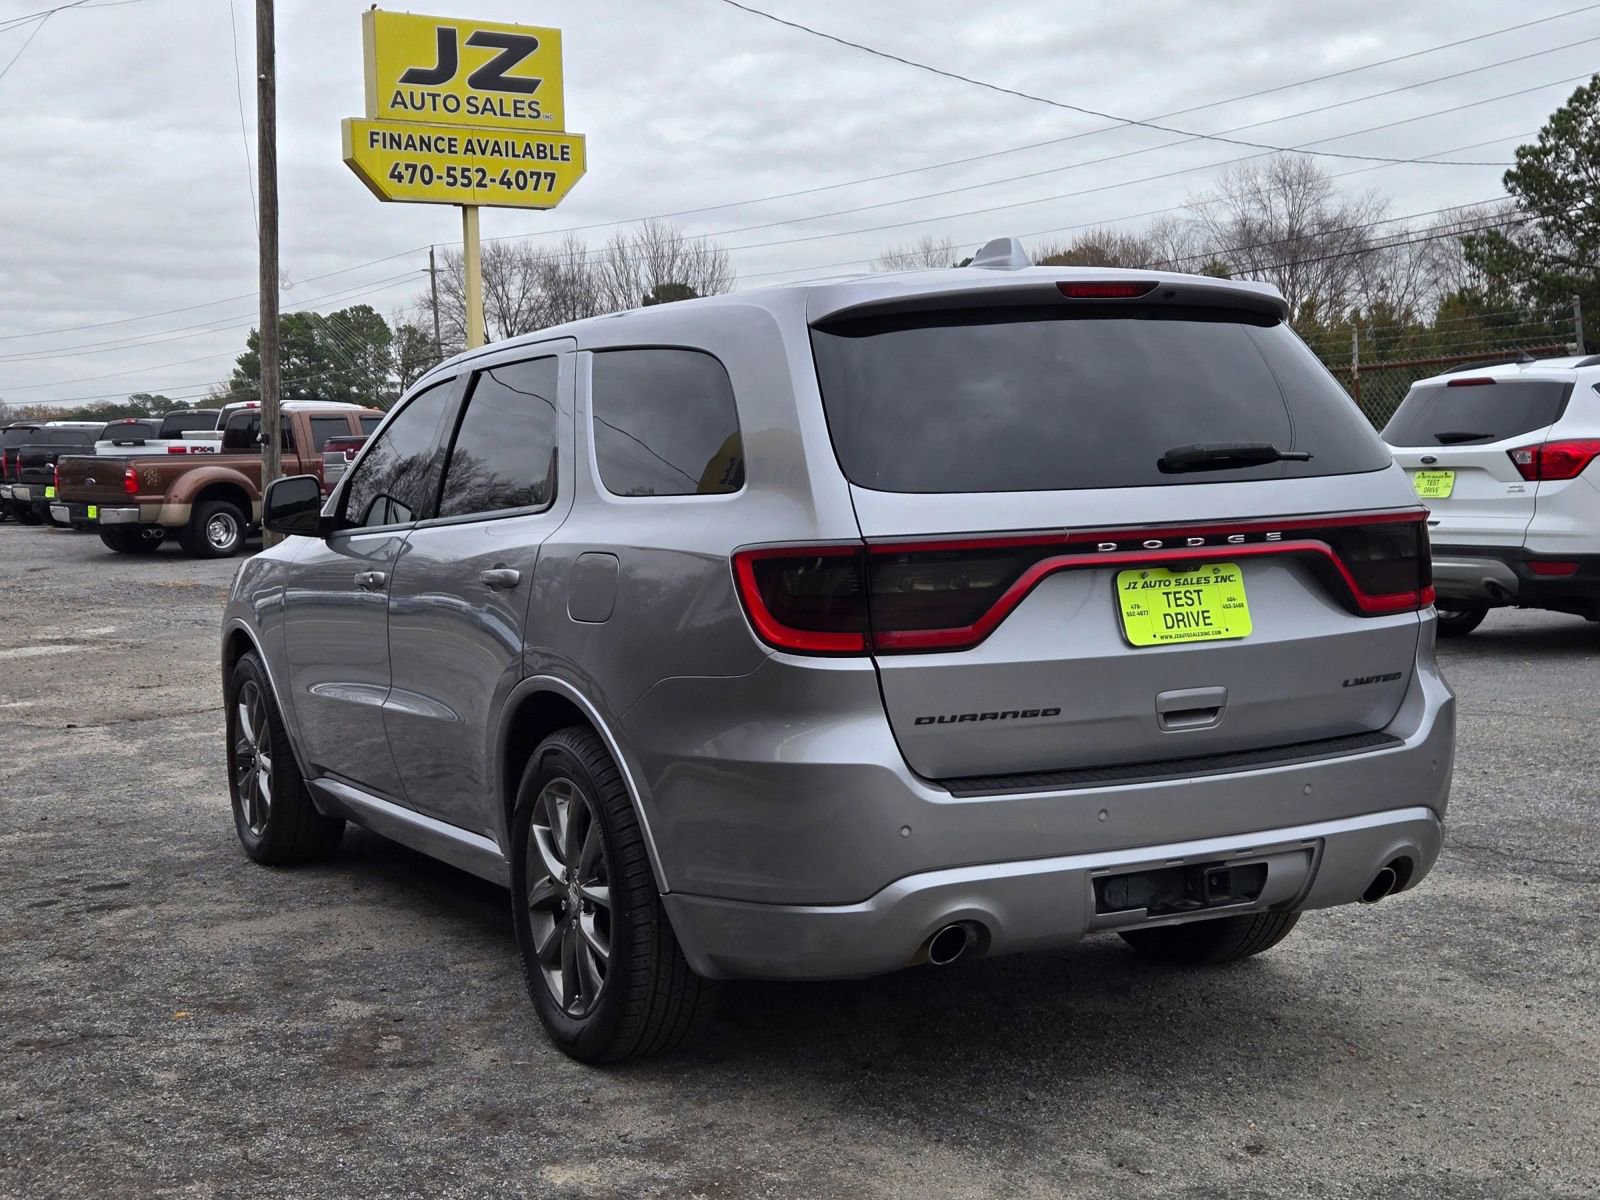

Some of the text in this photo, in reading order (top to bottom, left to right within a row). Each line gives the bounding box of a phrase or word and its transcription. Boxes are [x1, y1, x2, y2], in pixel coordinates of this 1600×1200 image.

[398, 27, 542, 94] JZ
[390, 89, 461, 114] AUTO
[465, 95, 542, 120] SALES
[368, 131, 571, 162] FINANCE AVAILABLE
[389, 162, 557, 192] 470-552-4077
[1426, 479, 1441, 487] TEST
[1097, 532, 1282, 552] DODGE
[1124, 574, 1237, 590] JZ AUTO SALES INC.
[1162, 589, 1204, 608] TEST
[1163, 610, 1213, 630] DRIVE
[914, 707, 1062, 725] DURANGO
